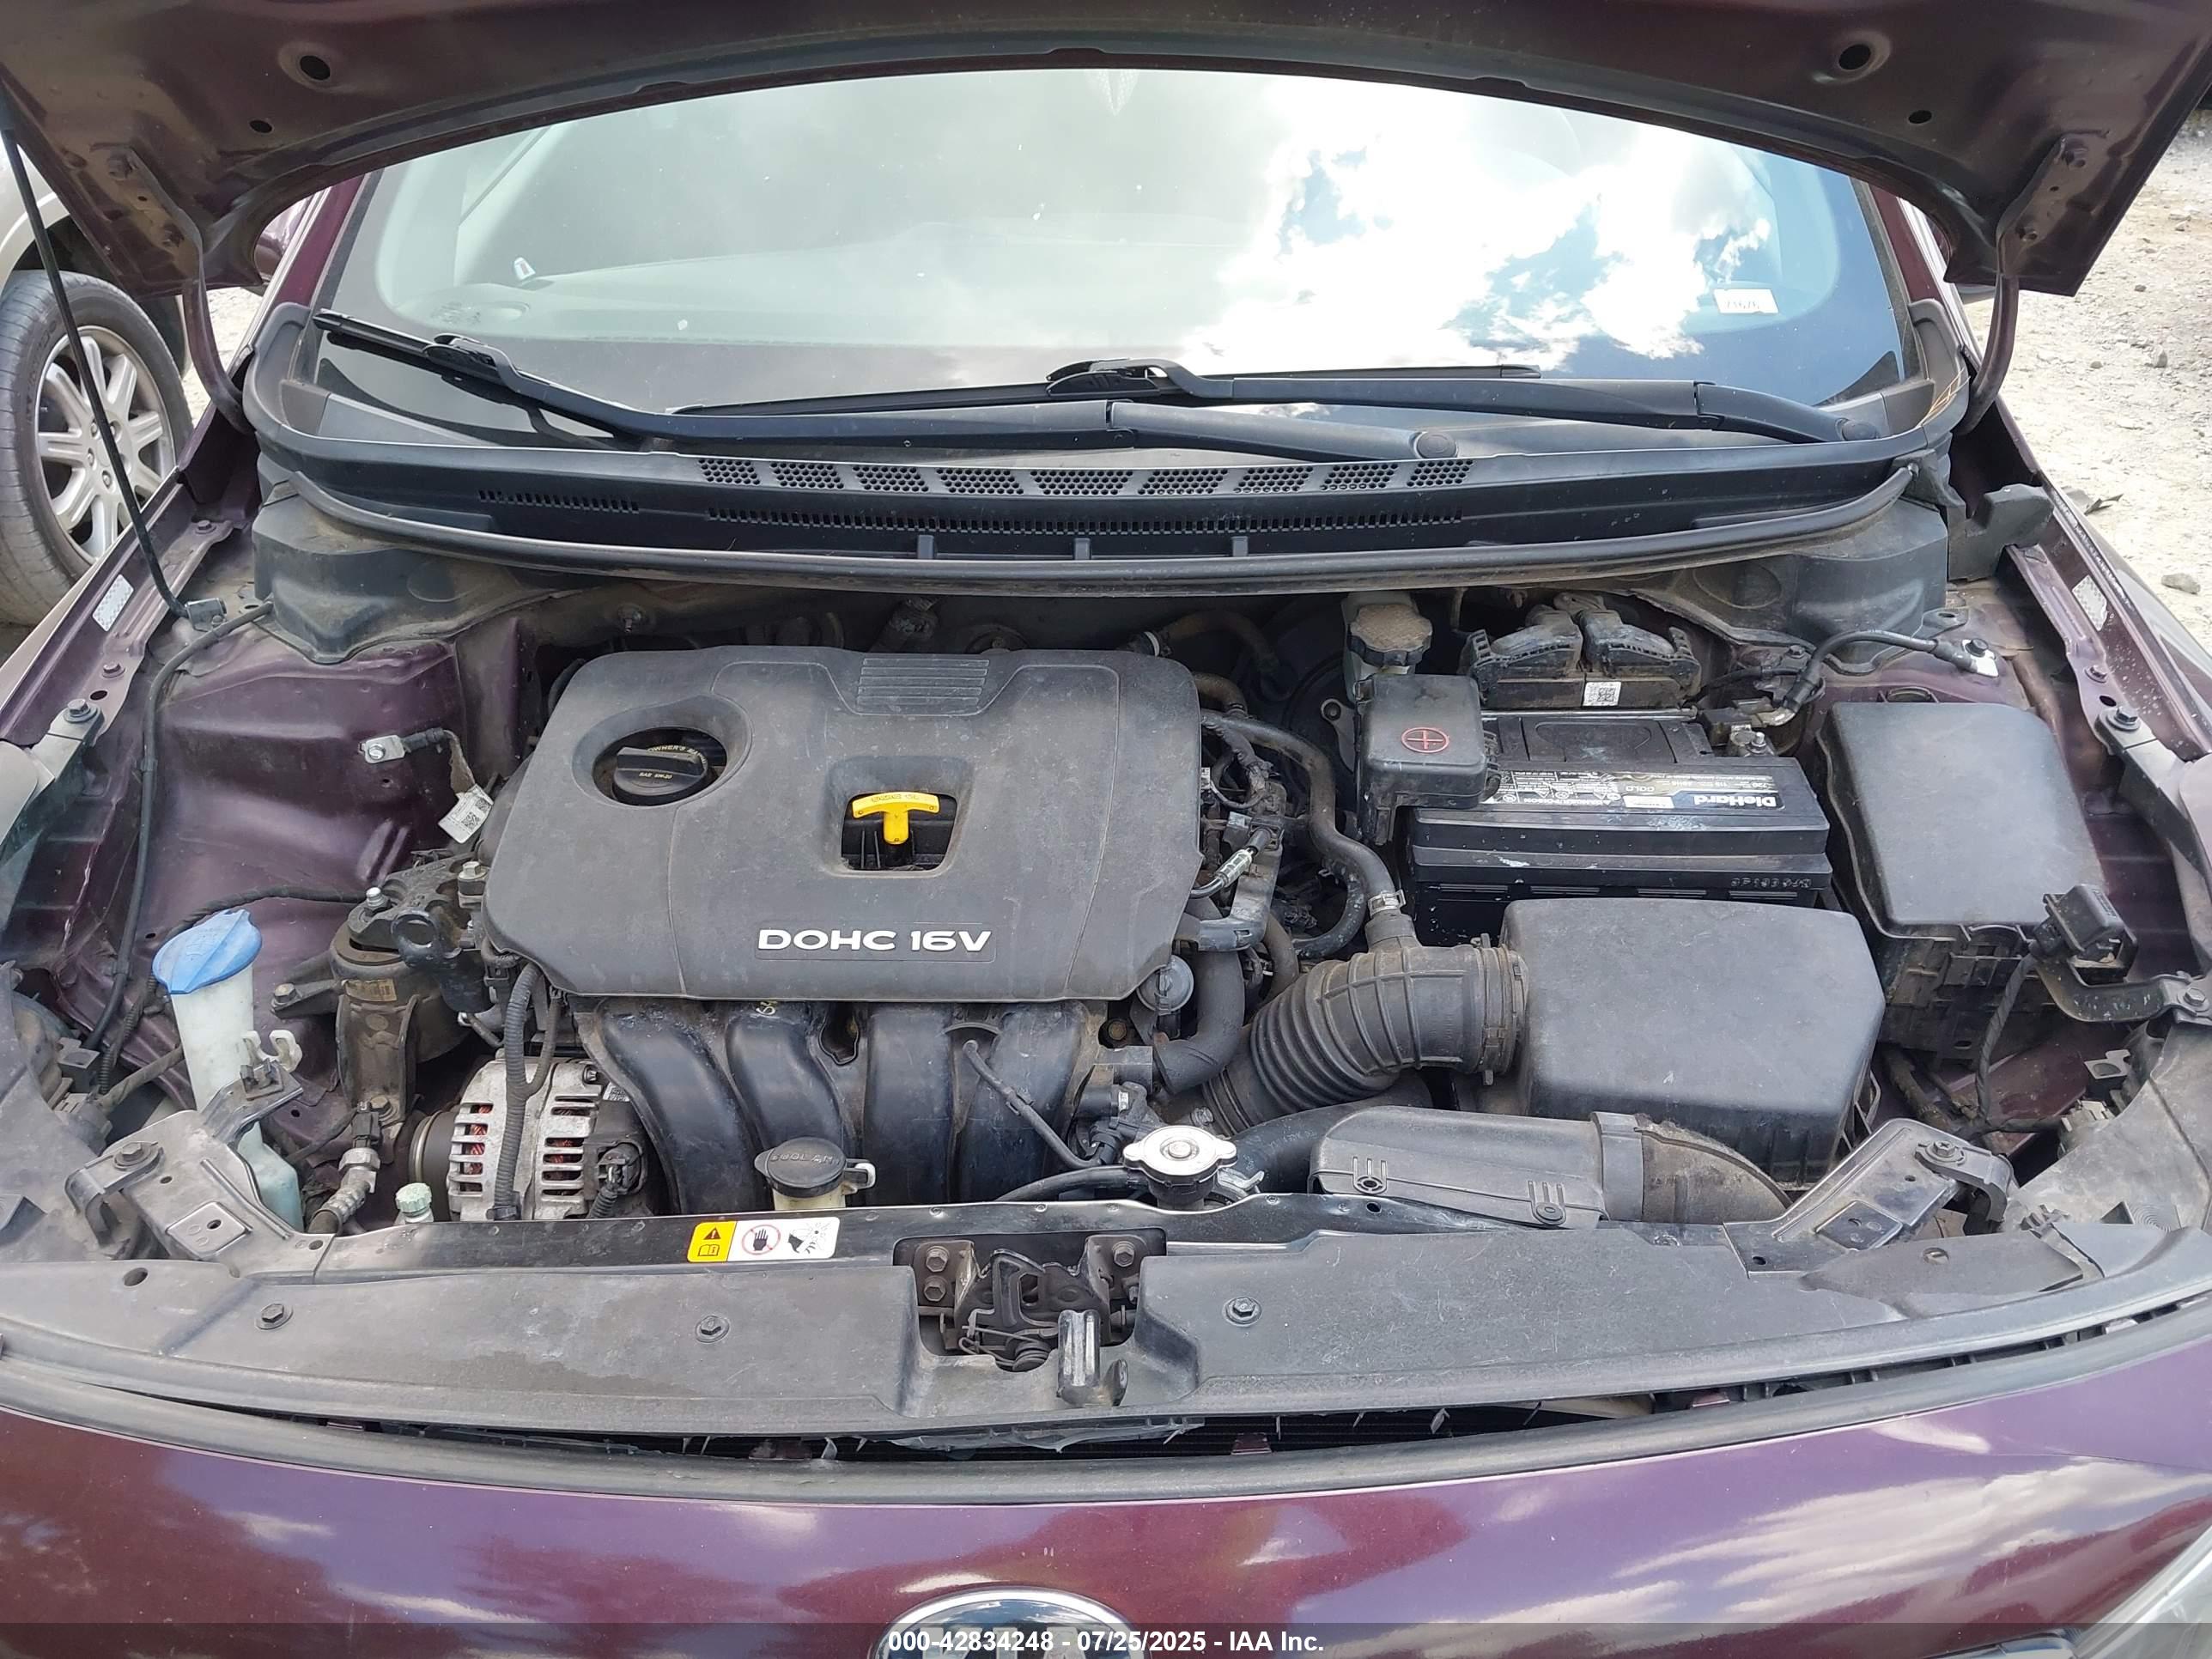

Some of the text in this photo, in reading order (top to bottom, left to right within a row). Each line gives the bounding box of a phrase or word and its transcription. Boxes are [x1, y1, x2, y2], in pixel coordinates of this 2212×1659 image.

[647, 744, 686, 753] OWNER'S
[1693, 794, 1778, 807] DieHard
[758, 929, 992, 951] DOHC 16V
